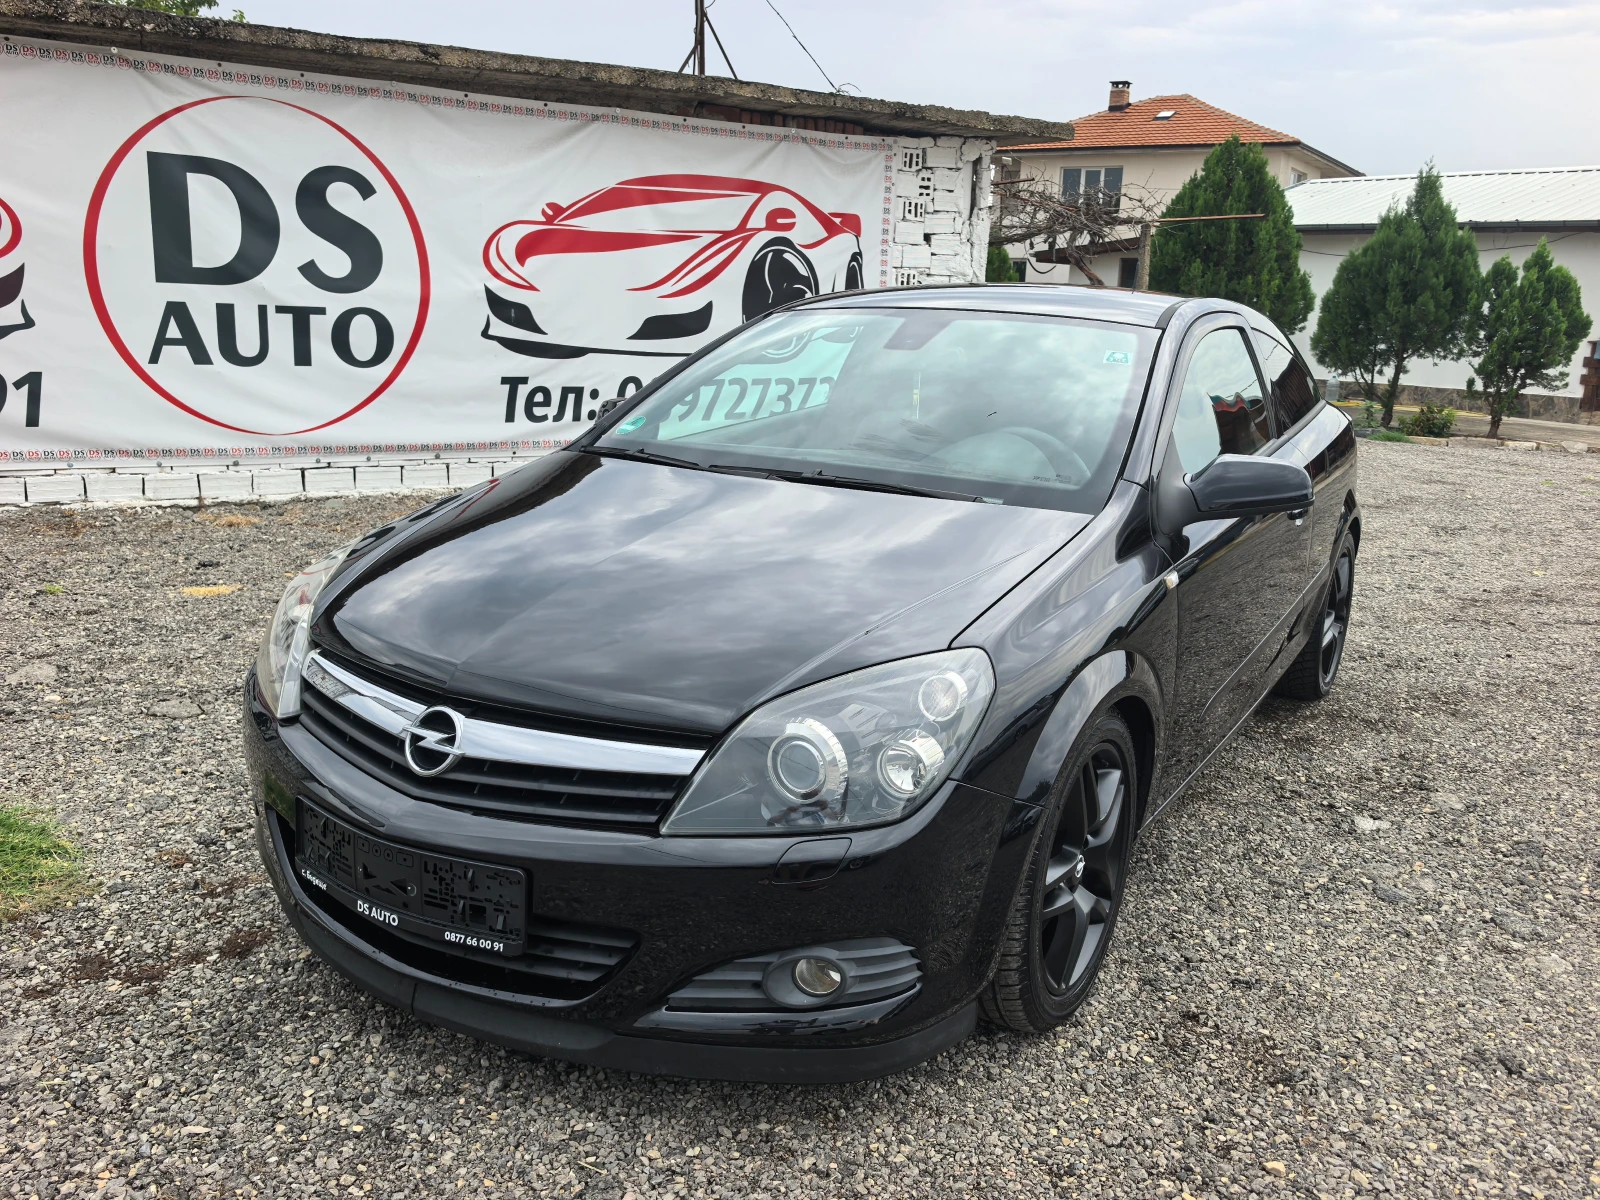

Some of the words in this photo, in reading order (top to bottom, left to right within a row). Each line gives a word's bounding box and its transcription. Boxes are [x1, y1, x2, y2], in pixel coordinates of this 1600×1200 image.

[146, 151, 383, 293] DS
[148, 301, 394, 368] AUTO
[500, 376, 599, 423] Тел:
[357, 900, 370, 915] DS
[371, 907, 399, 926] AUTO
[444, 931, 465, 943] 0877
[467, 936, 477, 946] 66
[480, 939, 491, 949] 00
[493, 942, 504, 952] 91
